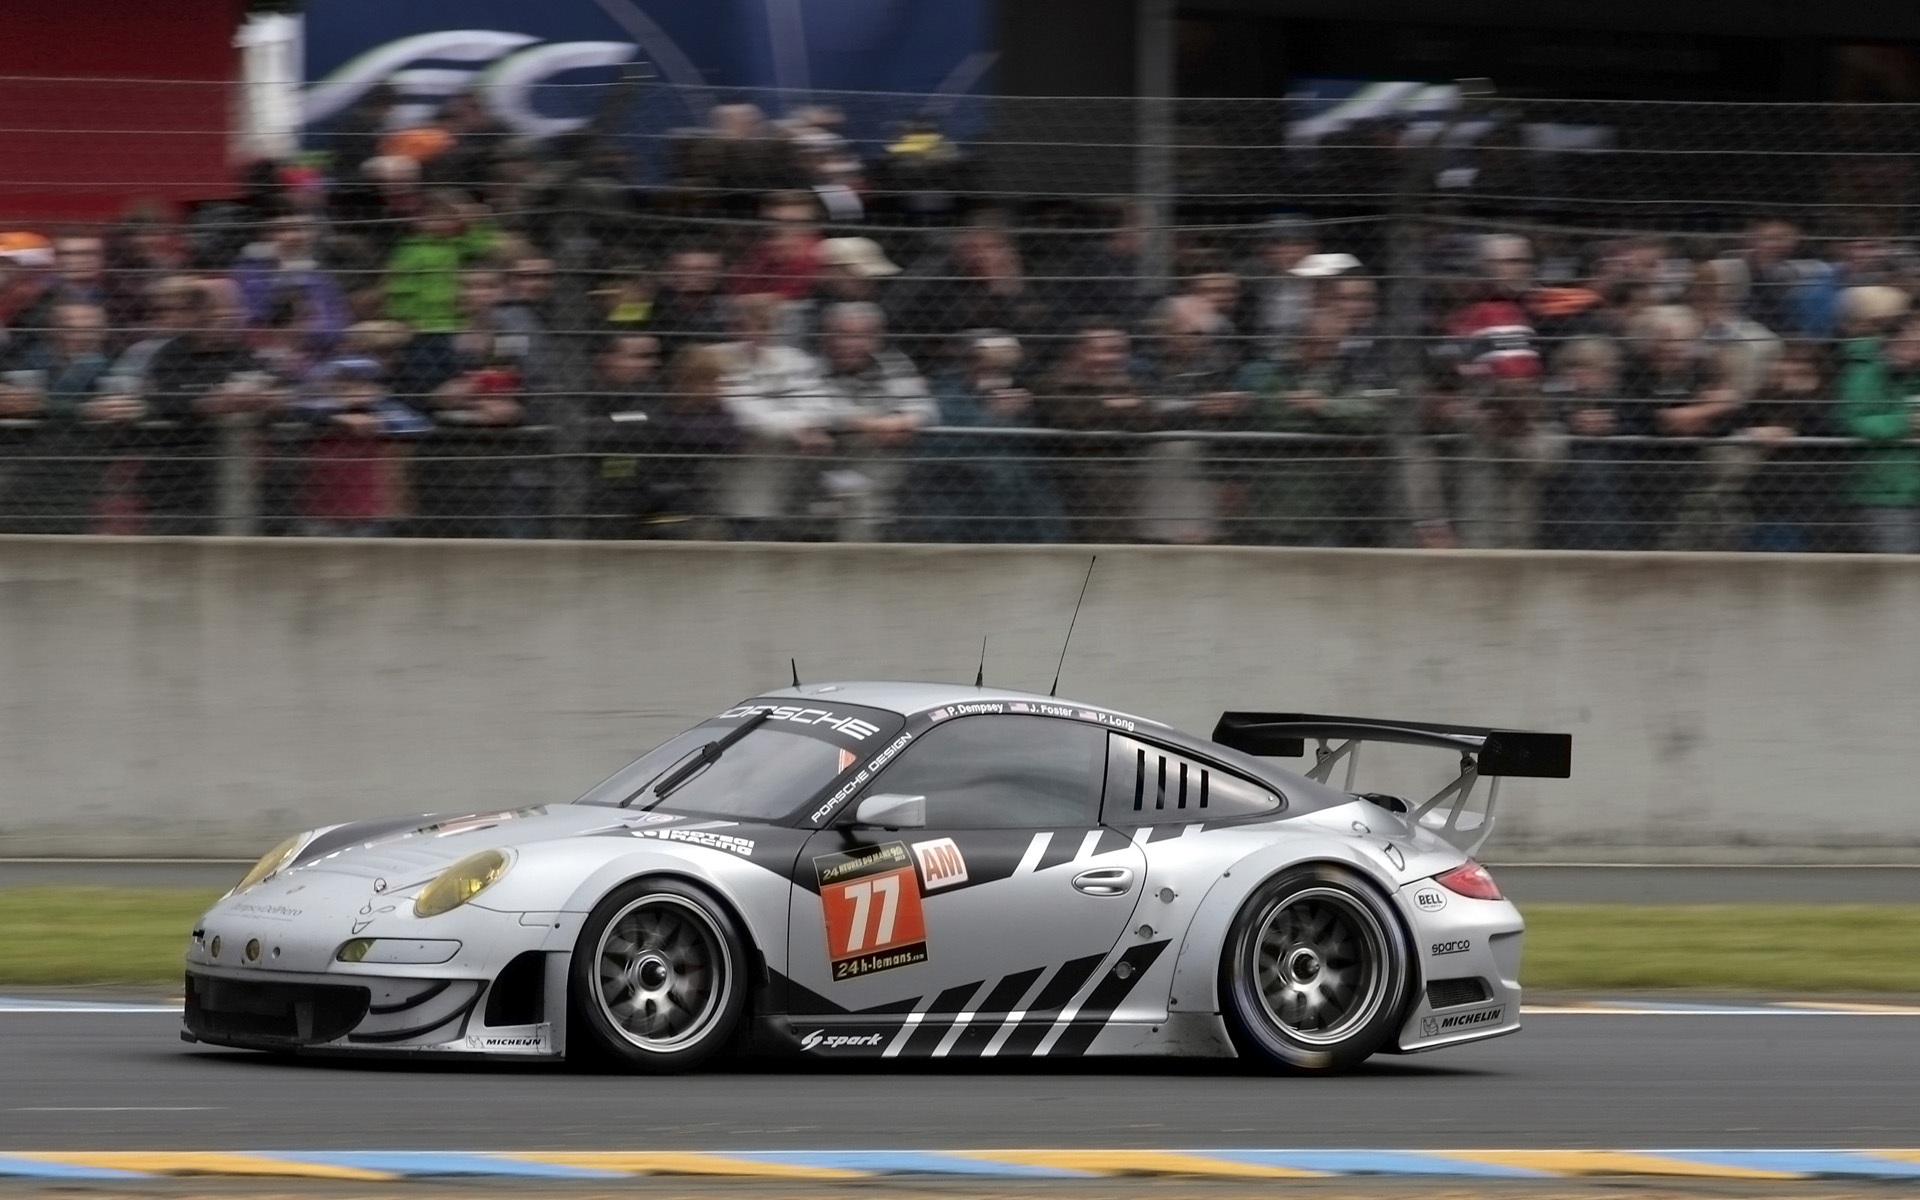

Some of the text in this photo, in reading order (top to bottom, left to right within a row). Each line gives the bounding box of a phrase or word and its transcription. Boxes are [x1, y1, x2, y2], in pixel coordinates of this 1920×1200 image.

[947, 703, 1004, 716] P. Dempsey
[1030, 704, 1073, 717] J. Foster
[717, 705, 880, 741] ORSCHE
[1098, 713, 1135, 731] P. Long
[811, 732, 913, 823] PORSCHE DESIGN
[670, 830, 755, 848] MOTEGI
[670, 835, 753, 856] RACING
[823, 865, 840, 880] 24
[839, 858, 862, 874] HEURES
[862, 855, 872, 866] DU
[872, 848, 891, 862] MANS
[923, 844, 963, 882] AM
[1418, 893, 1443, 906] BELL
[844, 875, 900, 952] 77
[1431, 939, 1470, 956] sparco
[1441, 1009, 1501, 1028] MICHELIN
[822, 1033, 883, 1048] spark
